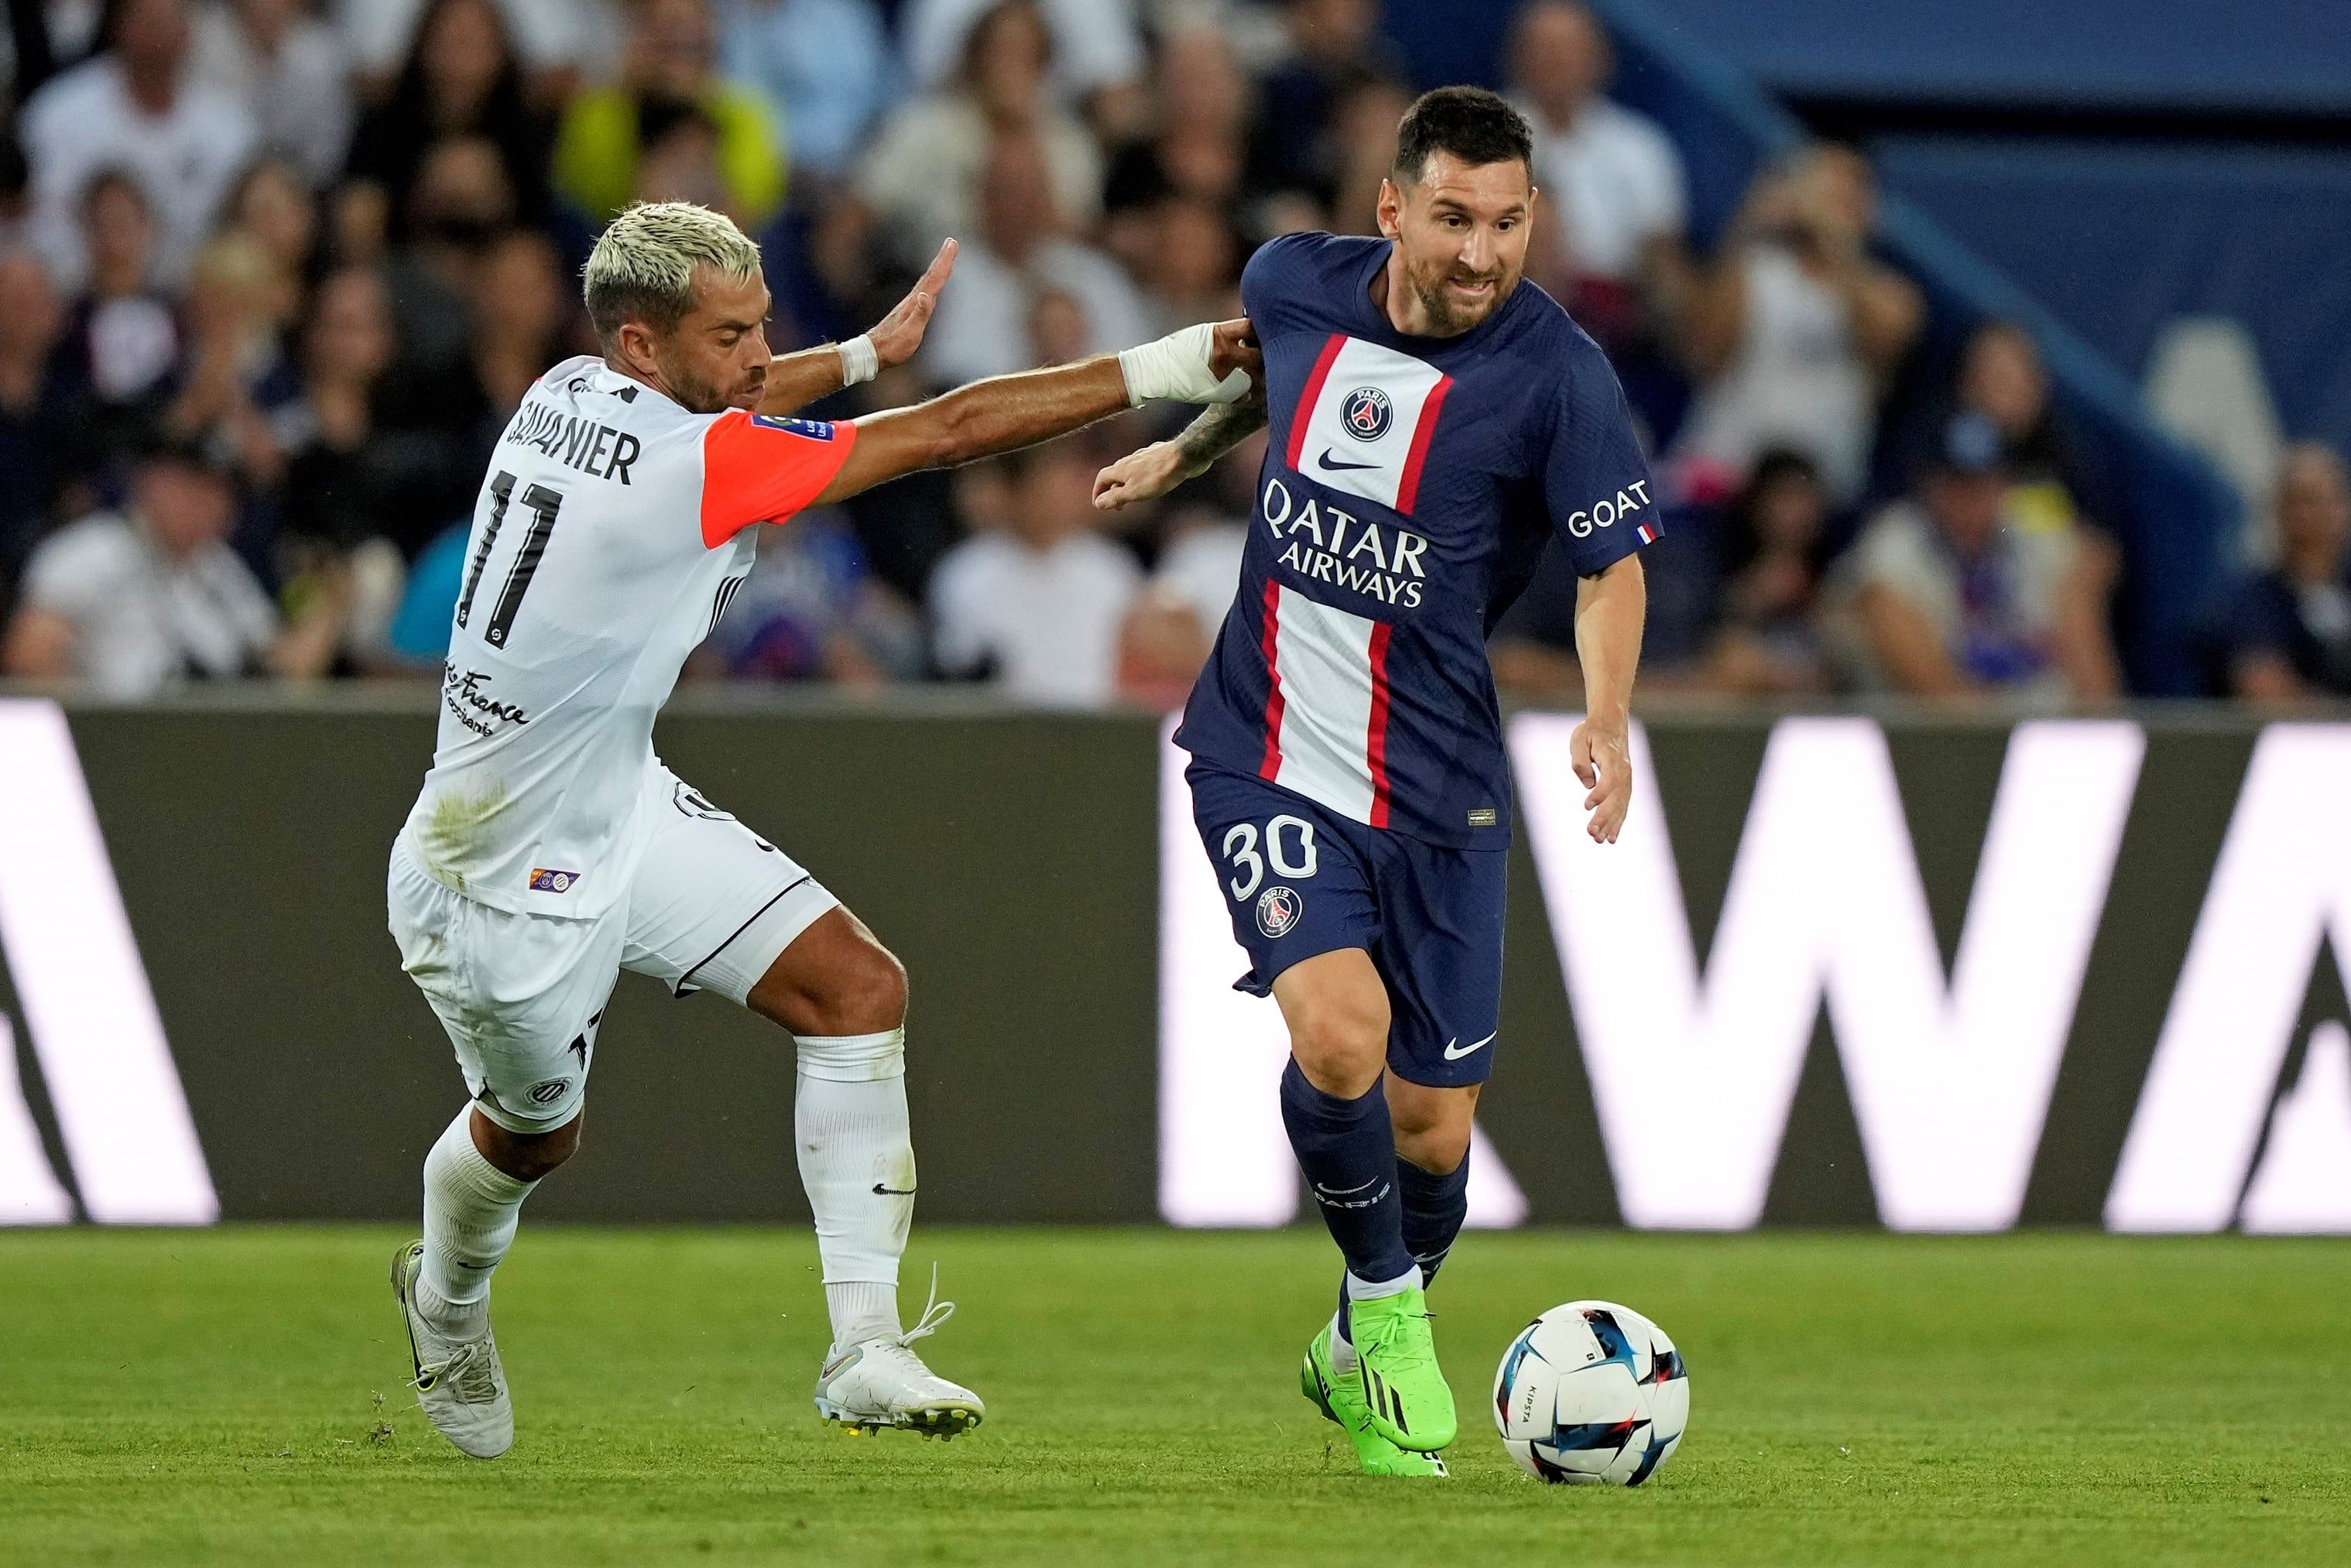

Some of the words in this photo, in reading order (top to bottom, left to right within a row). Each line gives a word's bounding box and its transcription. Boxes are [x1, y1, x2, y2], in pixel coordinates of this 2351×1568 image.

[1356, 390, 1387, 409] PARIS
[507, 400, 640, 485] SAVANIER
[1263, 478, 1428, 578] QATAR
[1568, 479, 1650, 538] GOAT
[457, 470, 564, 649] 11
[1277, 541, 1423, 608] AIRWAYS
[461, 669, 531, 724] France
[1222, 814, 1318, 902] 30
[1259, 888, 1290, 908] PARIS
[1523, 1385, 1537, 1422] KIPSTA
